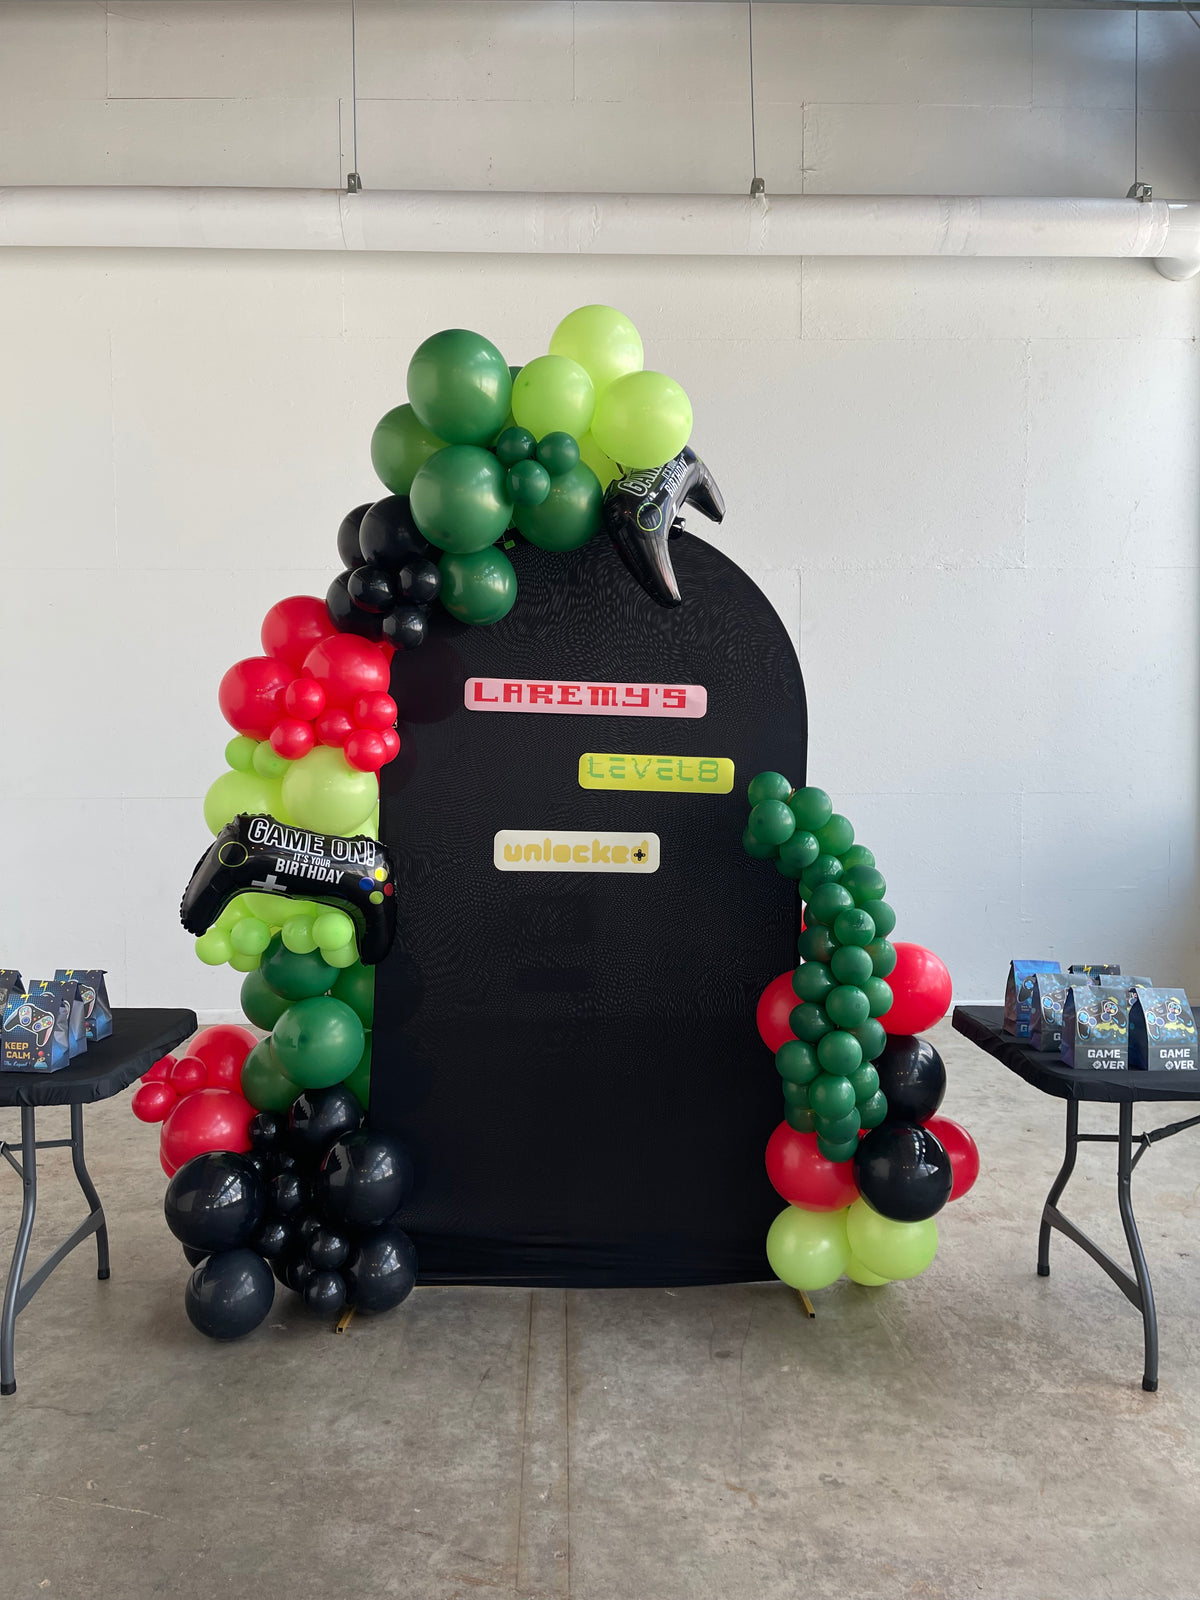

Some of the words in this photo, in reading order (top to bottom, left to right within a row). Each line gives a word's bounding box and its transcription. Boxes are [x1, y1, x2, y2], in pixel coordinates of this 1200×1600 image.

[664, 457, 689, 498] BIRTHDAY
[474, 682, 686, 709] LAREMY'S
[248, 818, 325, 856] GAME
[331, 839, 376, 867] ON!
[503, 837, 649, 864] unlocked
[293, 853, 309, 864] IT'S
[311, 855, 331, 868] YOUR
[275, 858, 345, 885] BIRTHDAY
[5, 1041, 28, 1050] KEEP
[6, 1051, 31, 1059] CALM
[1087, 1049, 1121, 1059] GAME
[1159, 1048, 1191, 1059] GAME
